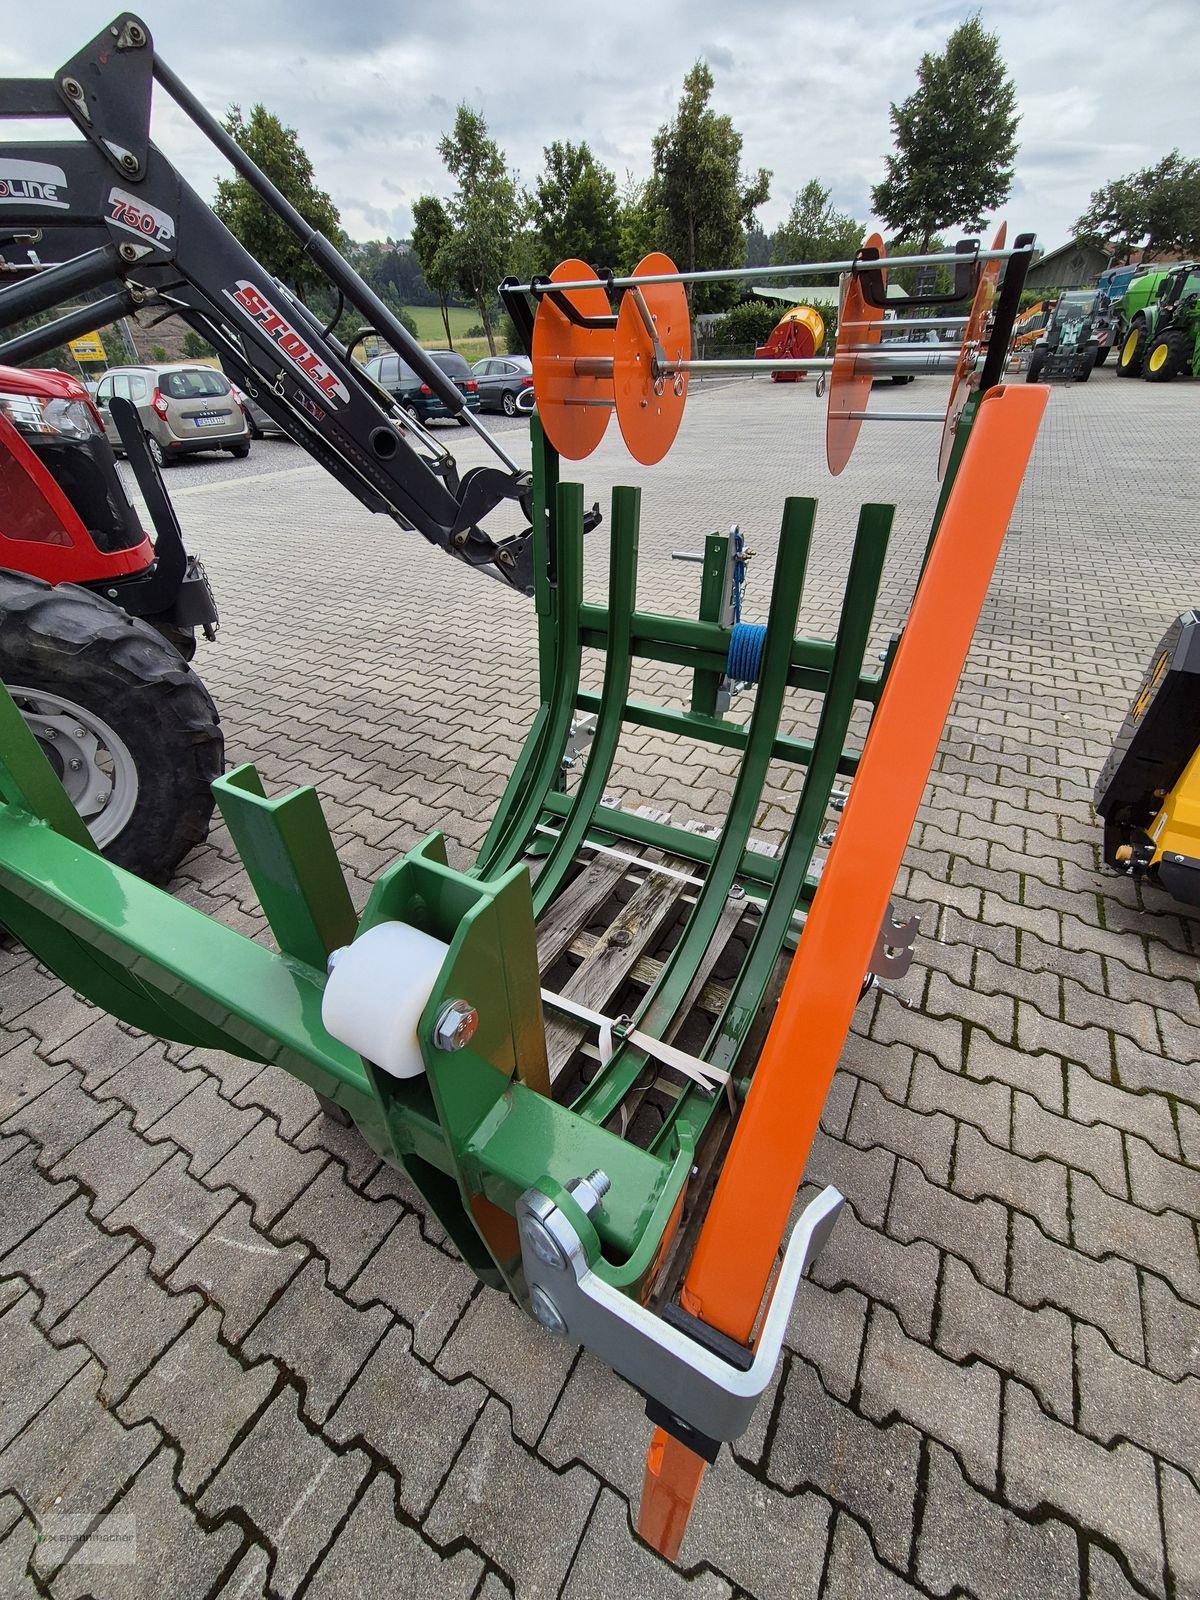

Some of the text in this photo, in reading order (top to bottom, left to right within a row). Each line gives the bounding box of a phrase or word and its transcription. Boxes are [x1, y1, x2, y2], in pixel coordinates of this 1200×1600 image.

[111, 198, 174, 241] 750 P
[233, 286, 343, 400] STOLL
